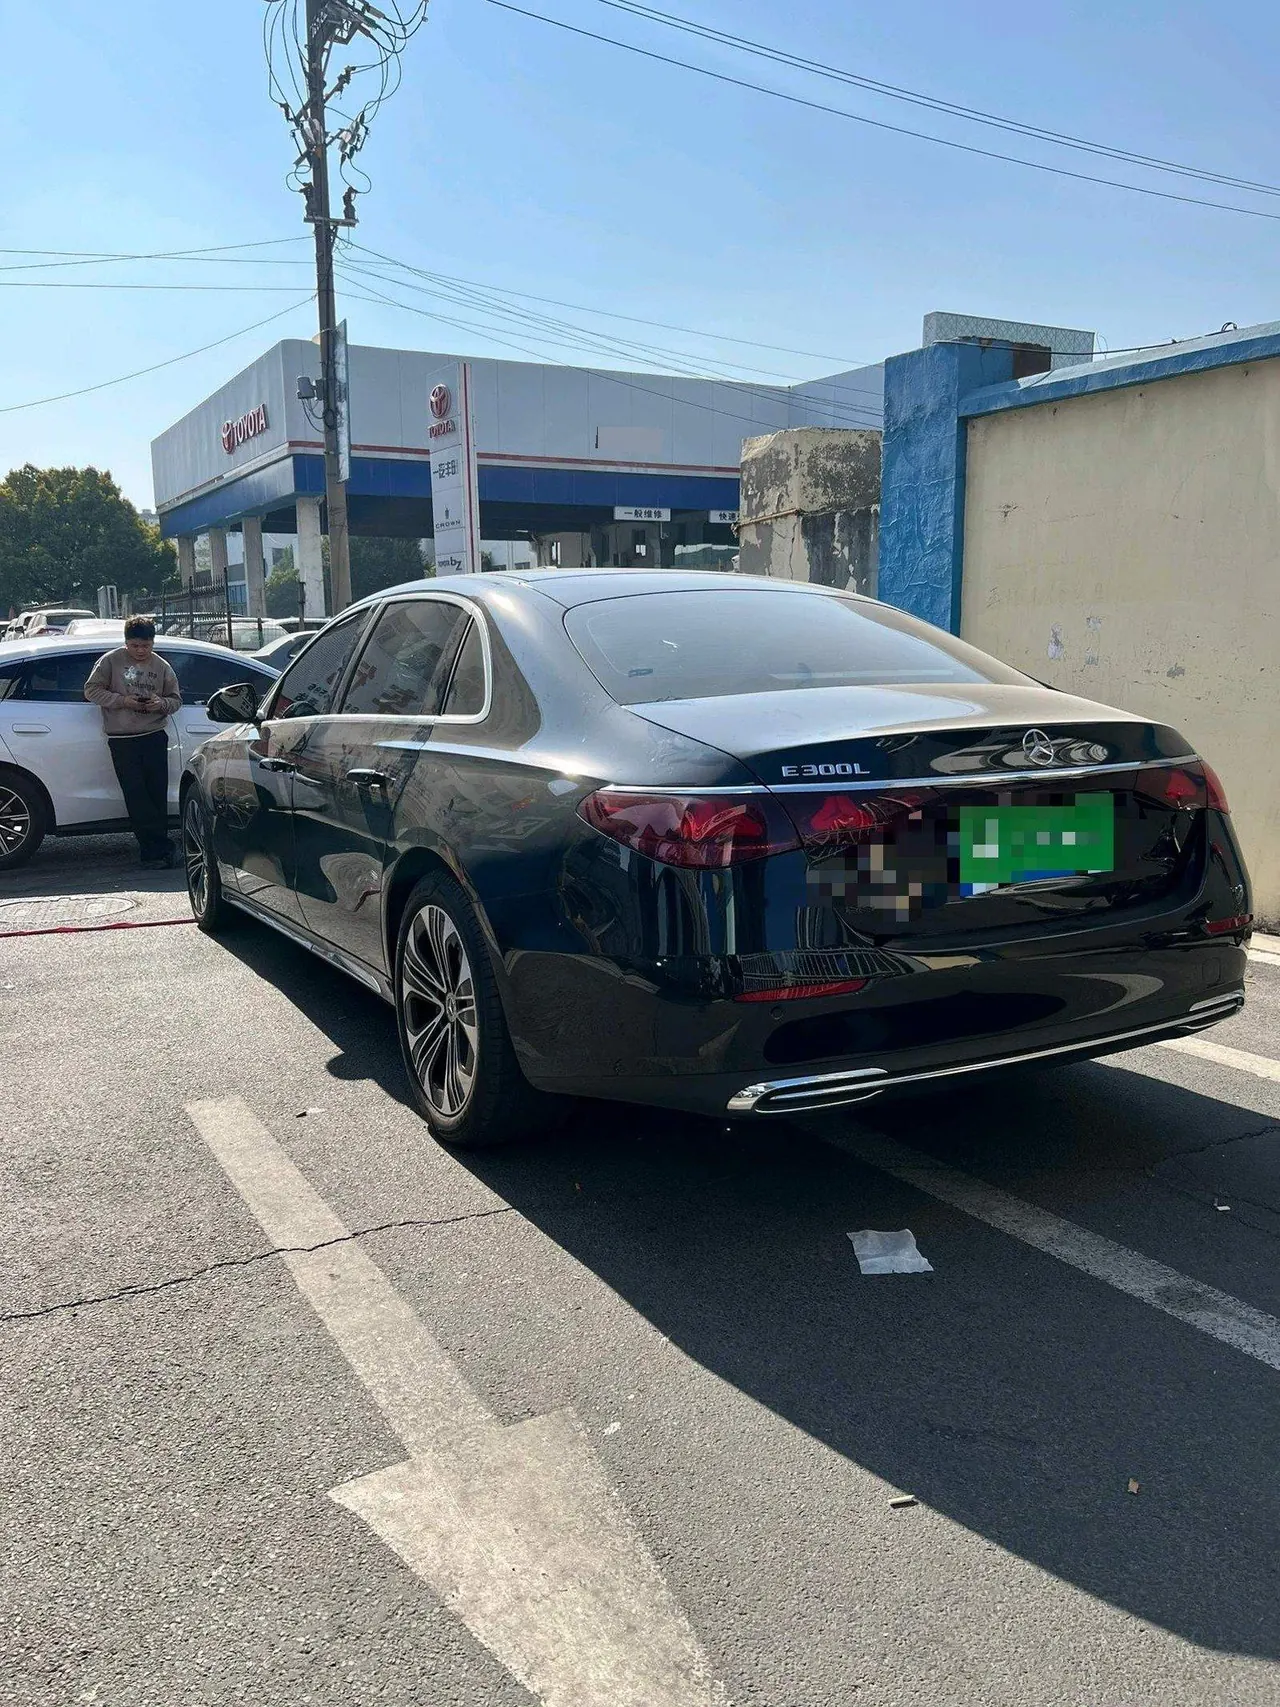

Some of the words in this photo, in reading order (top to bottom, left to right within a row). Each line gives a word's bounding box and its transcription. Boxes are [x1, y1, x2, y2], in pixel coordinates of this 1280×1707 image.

[232, 404, 268, 447] TOYOTA
[427, 420, 455, 439] TOYOTA
[624, 509, 662, 519] 一般维修
[718, 512, 740, 521] 快速
[435, 520, 461, 529] CROWN
